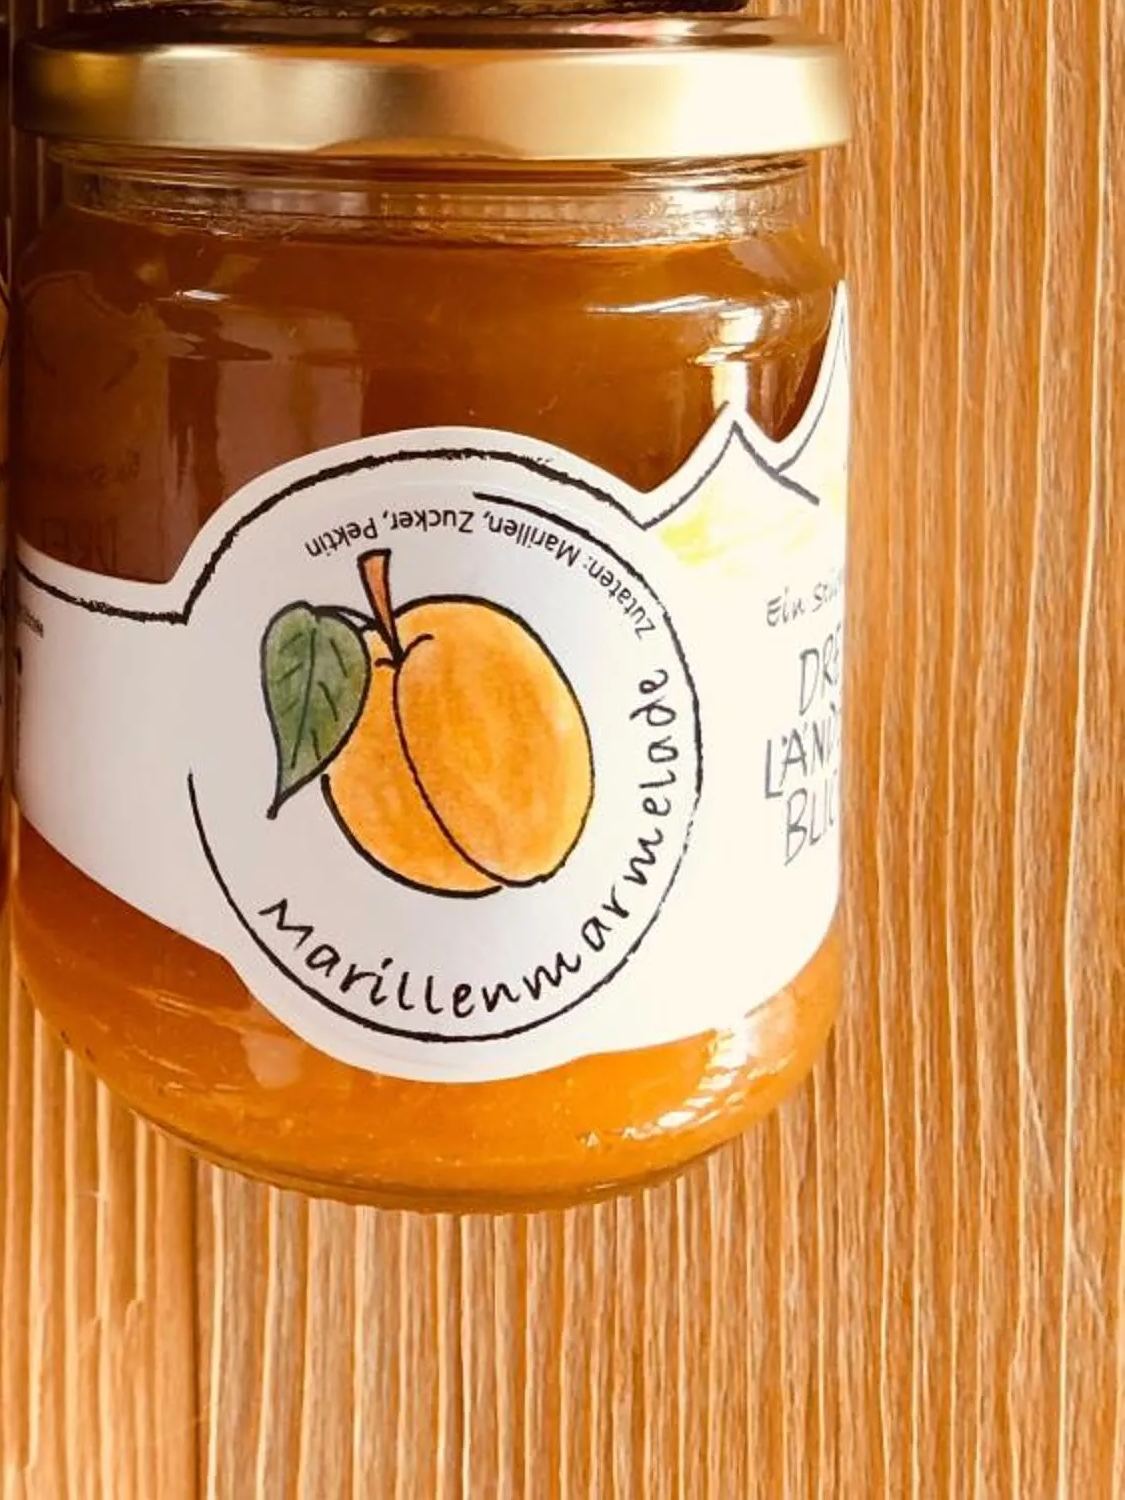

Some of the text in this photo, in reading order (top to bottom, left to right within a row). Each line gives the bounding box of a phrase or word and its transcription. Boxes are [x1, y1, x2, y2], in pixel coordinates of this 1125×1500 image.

[304, 508, 656, 641] Zutaten: Marillen, Zucker, Pektin
[259, 668, 679, 1018] Marillenmarmelade
